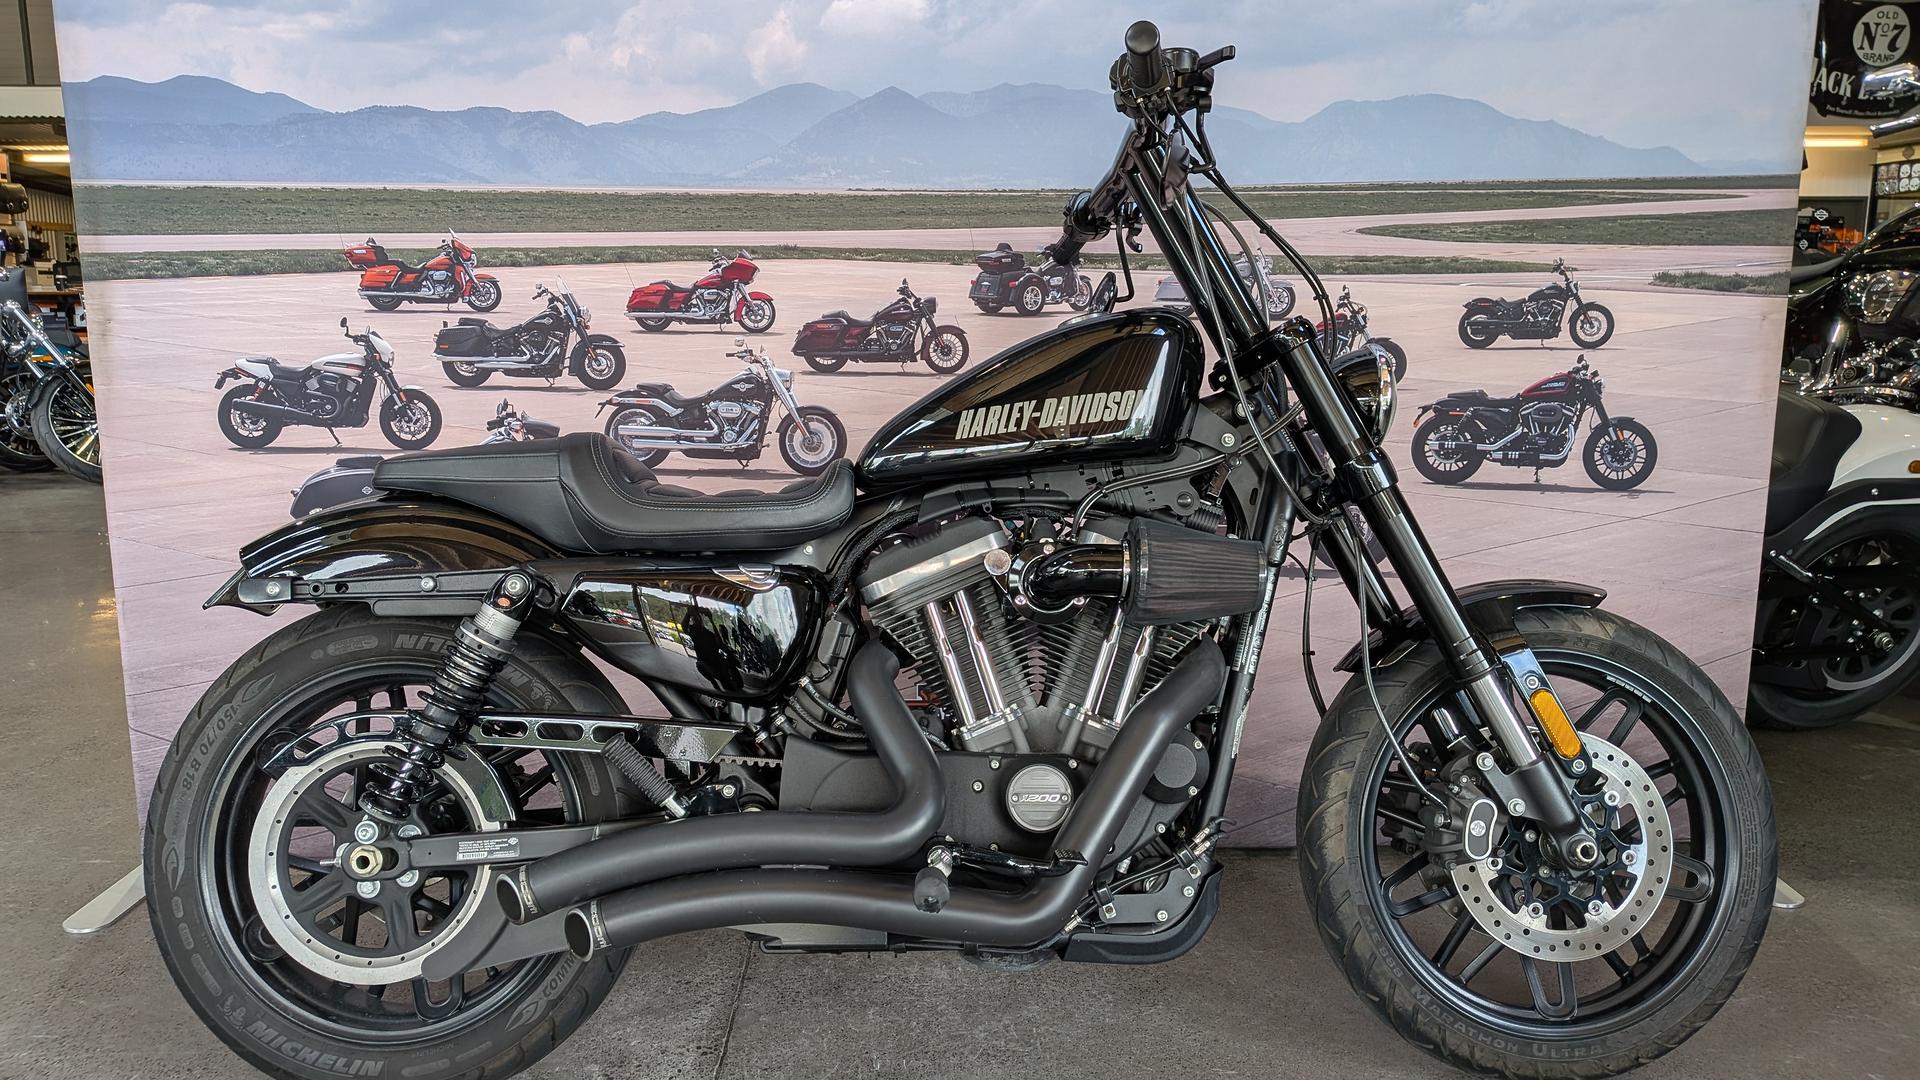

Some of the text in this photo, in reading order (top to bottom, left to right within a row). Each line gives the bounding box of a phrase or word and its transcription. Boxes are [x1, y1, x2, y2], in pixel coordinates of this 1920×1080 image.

[1876, 11, 1899, 19] OLD
[1810, 57, 1856, 105] ACK
[1862, 52, 1895, 63] BRAND
[199, 704, 241, 756] 150/70
[1019, 794, 1060, 803] 1200
[542, 952, 577, 998] COMM
[1410, 984, 1519, 1053] MARATHON
[1531, 1043, 1602, 1059] ULTRA
[248, 1020, 385, 1077] MICHELIN
